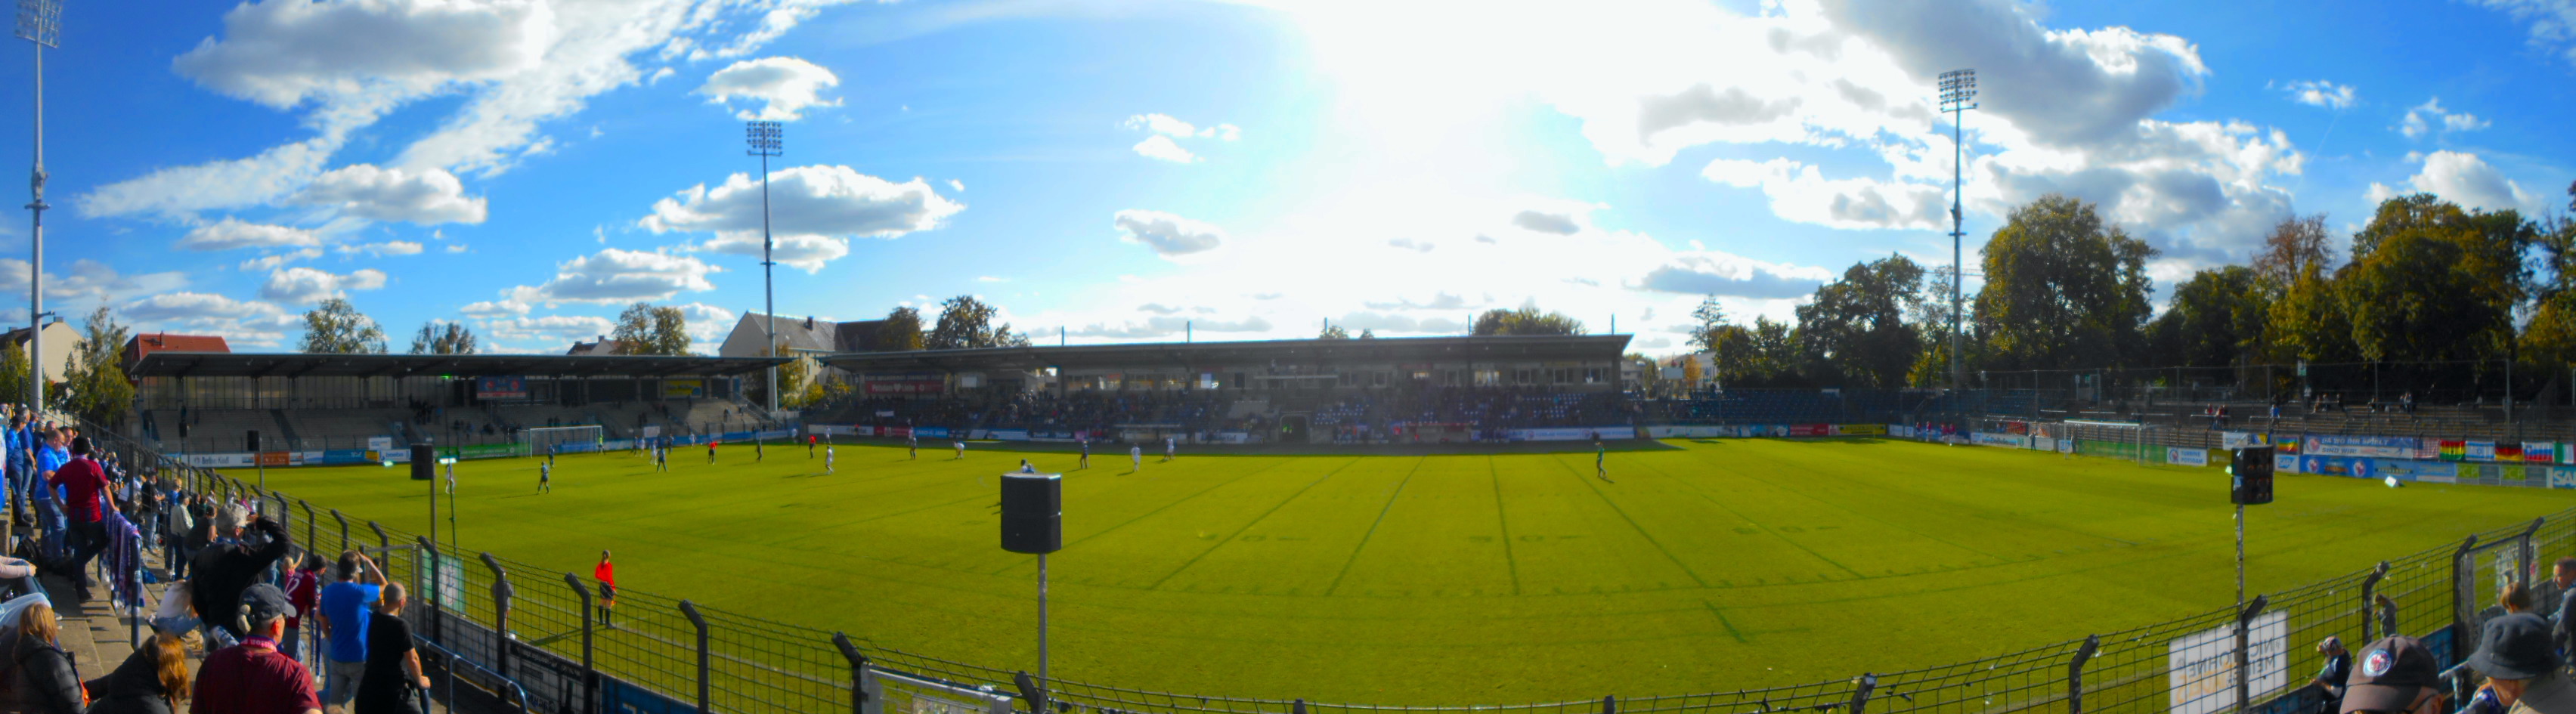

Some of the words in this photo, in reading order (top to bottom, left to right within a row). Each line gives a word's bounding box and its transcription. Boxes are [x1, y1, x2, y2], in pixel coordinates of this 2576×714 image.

[2363, 437, 2389, 447] SPIELT
[2181, 457, 2203, 465] POTSDAM
[2457, 465, 2479, 478] PCP
[2501, 467, 2525, 480] PCP
[2553, 469, 2576, 487] SA
[283, 576, 300, 601] 12
